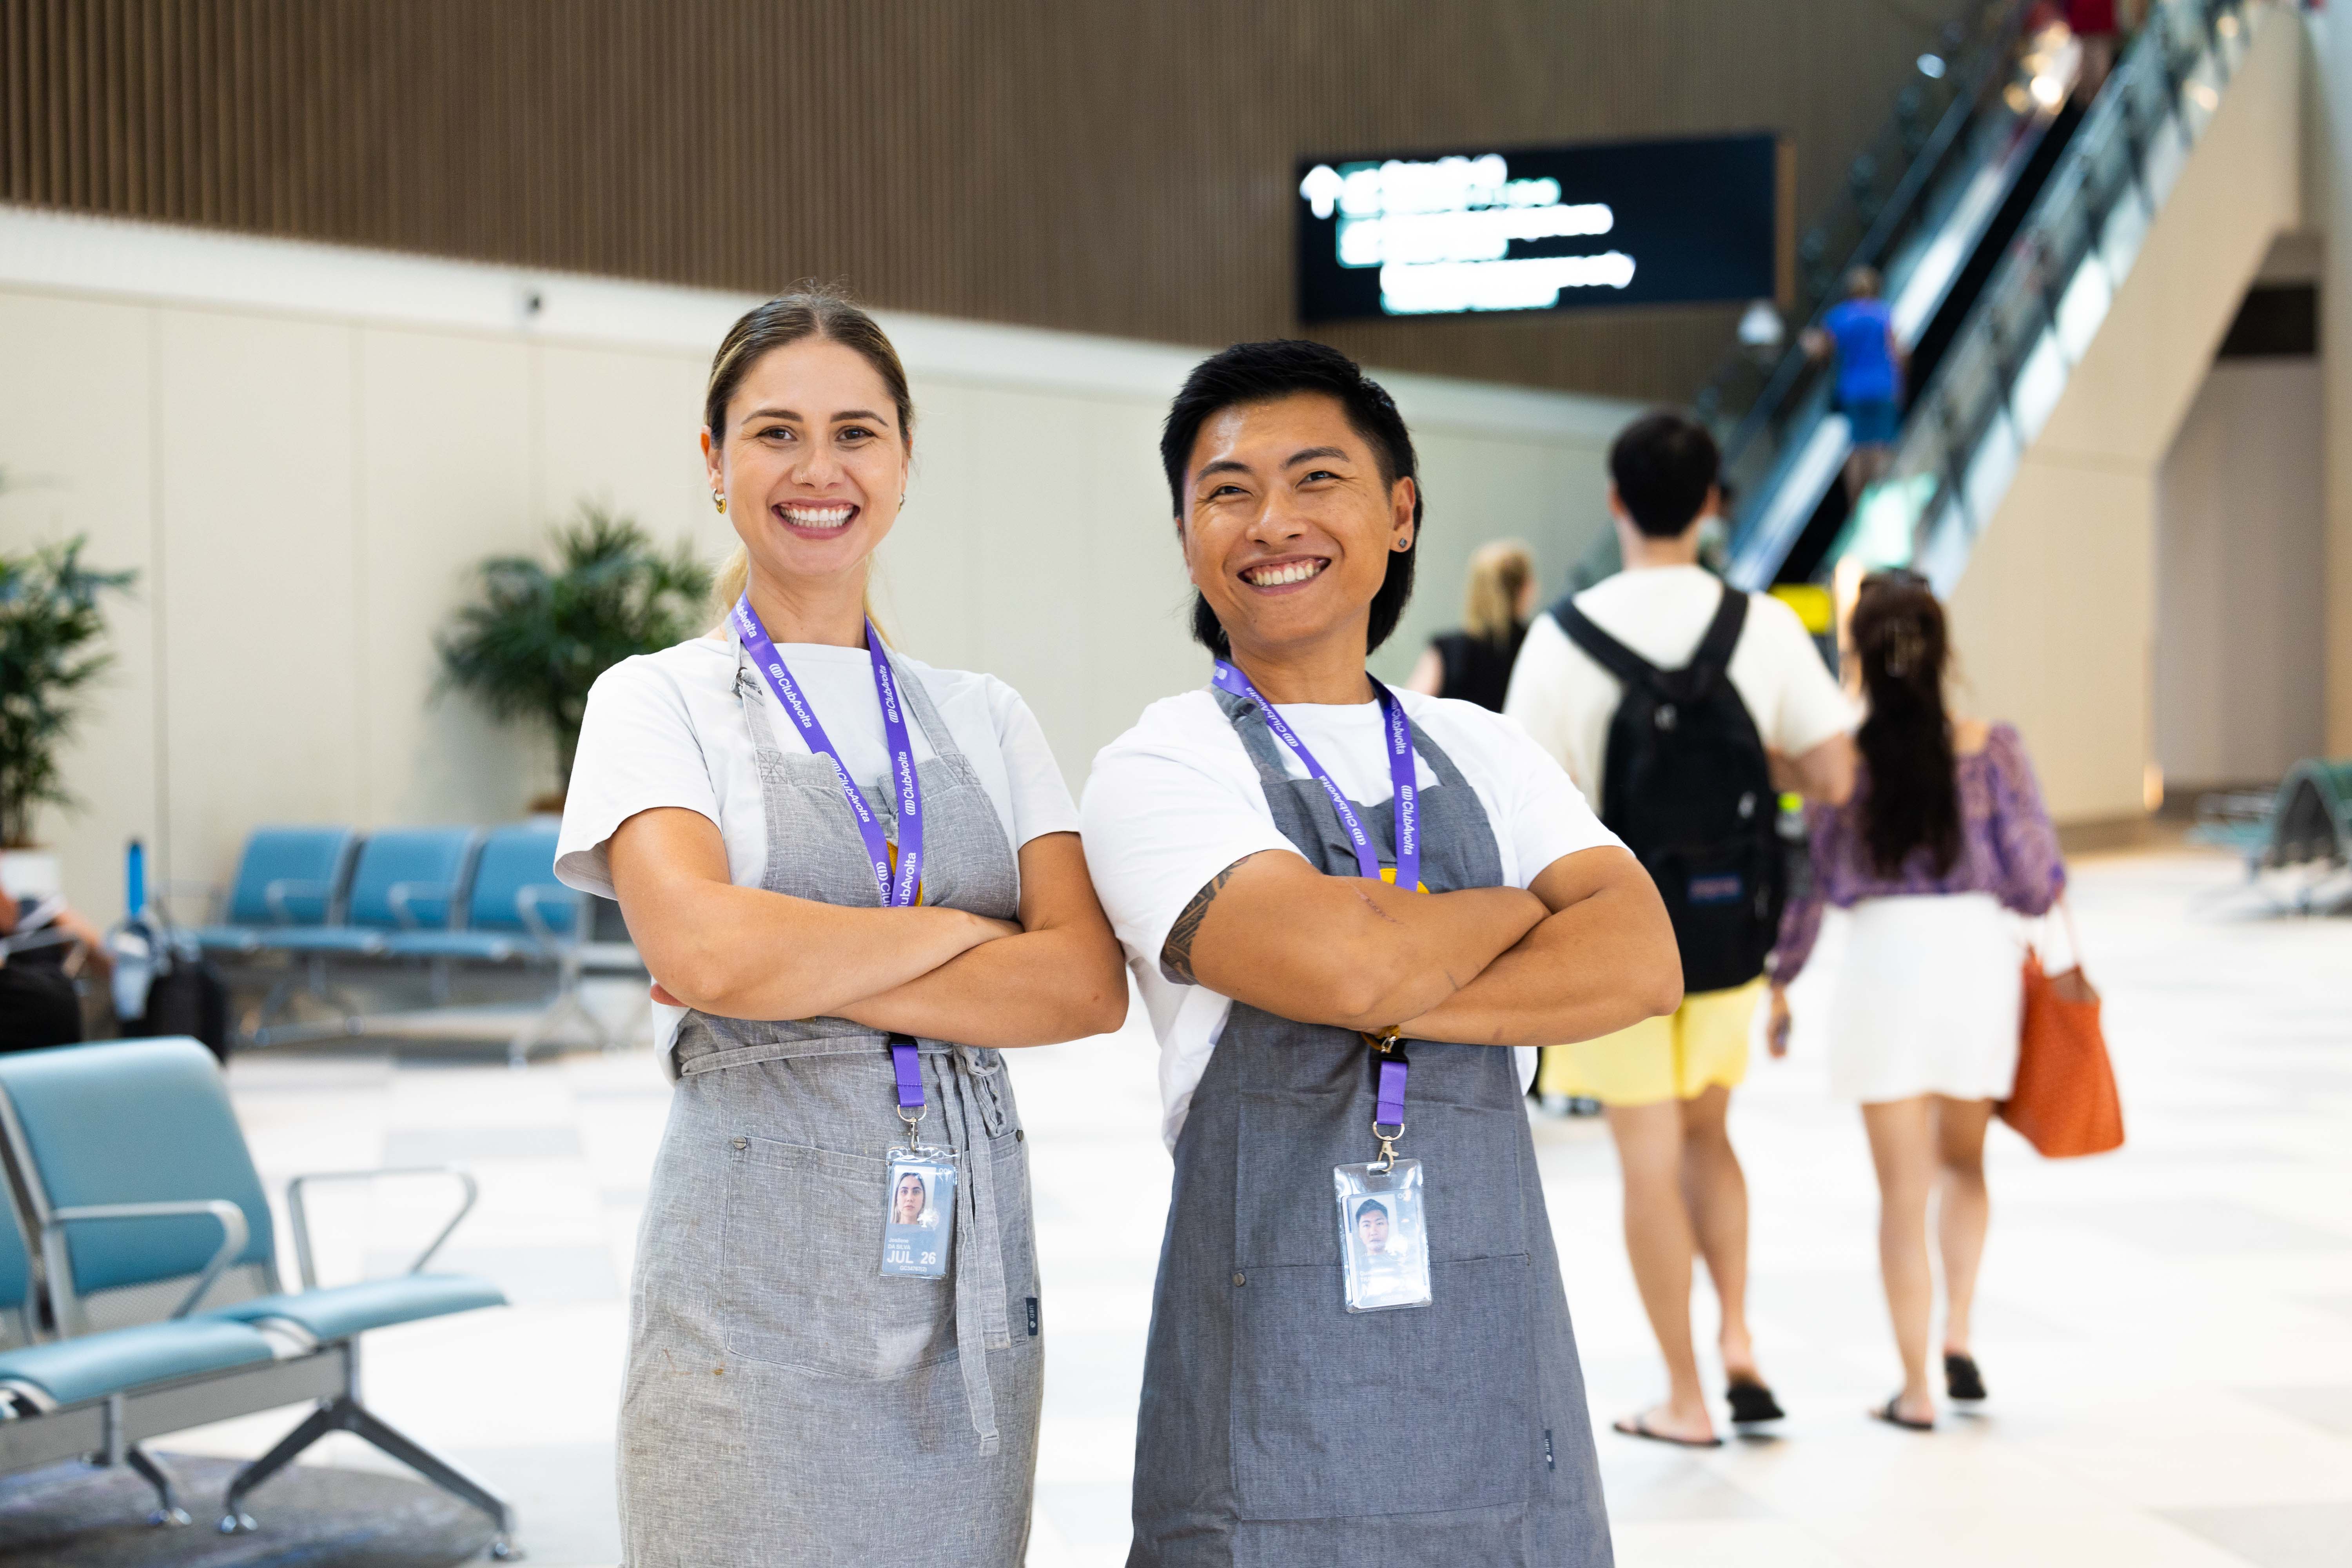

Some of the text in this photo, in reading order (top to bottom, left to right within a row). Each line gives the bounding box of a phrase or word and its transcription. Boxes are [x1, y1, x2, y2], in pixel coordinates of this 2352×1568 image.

[778, 678, 812, 728] ClubAvolta
[879, 665, 895, 708] ClubAvolta
[1246, 687, 1287, 732] ClubAvolta
[1392, 709, 1407, 755] ClubAvolta
[838, 772, 870, 822] ClubAvolta
[898, 751, 915, 800] ClubAvolta
[1319, 775, 1358, 827] ClubAvolta
[1402, 801, 1415, 855] ClubAvolta
[887, 1250, 936, 1265] JUL 26
